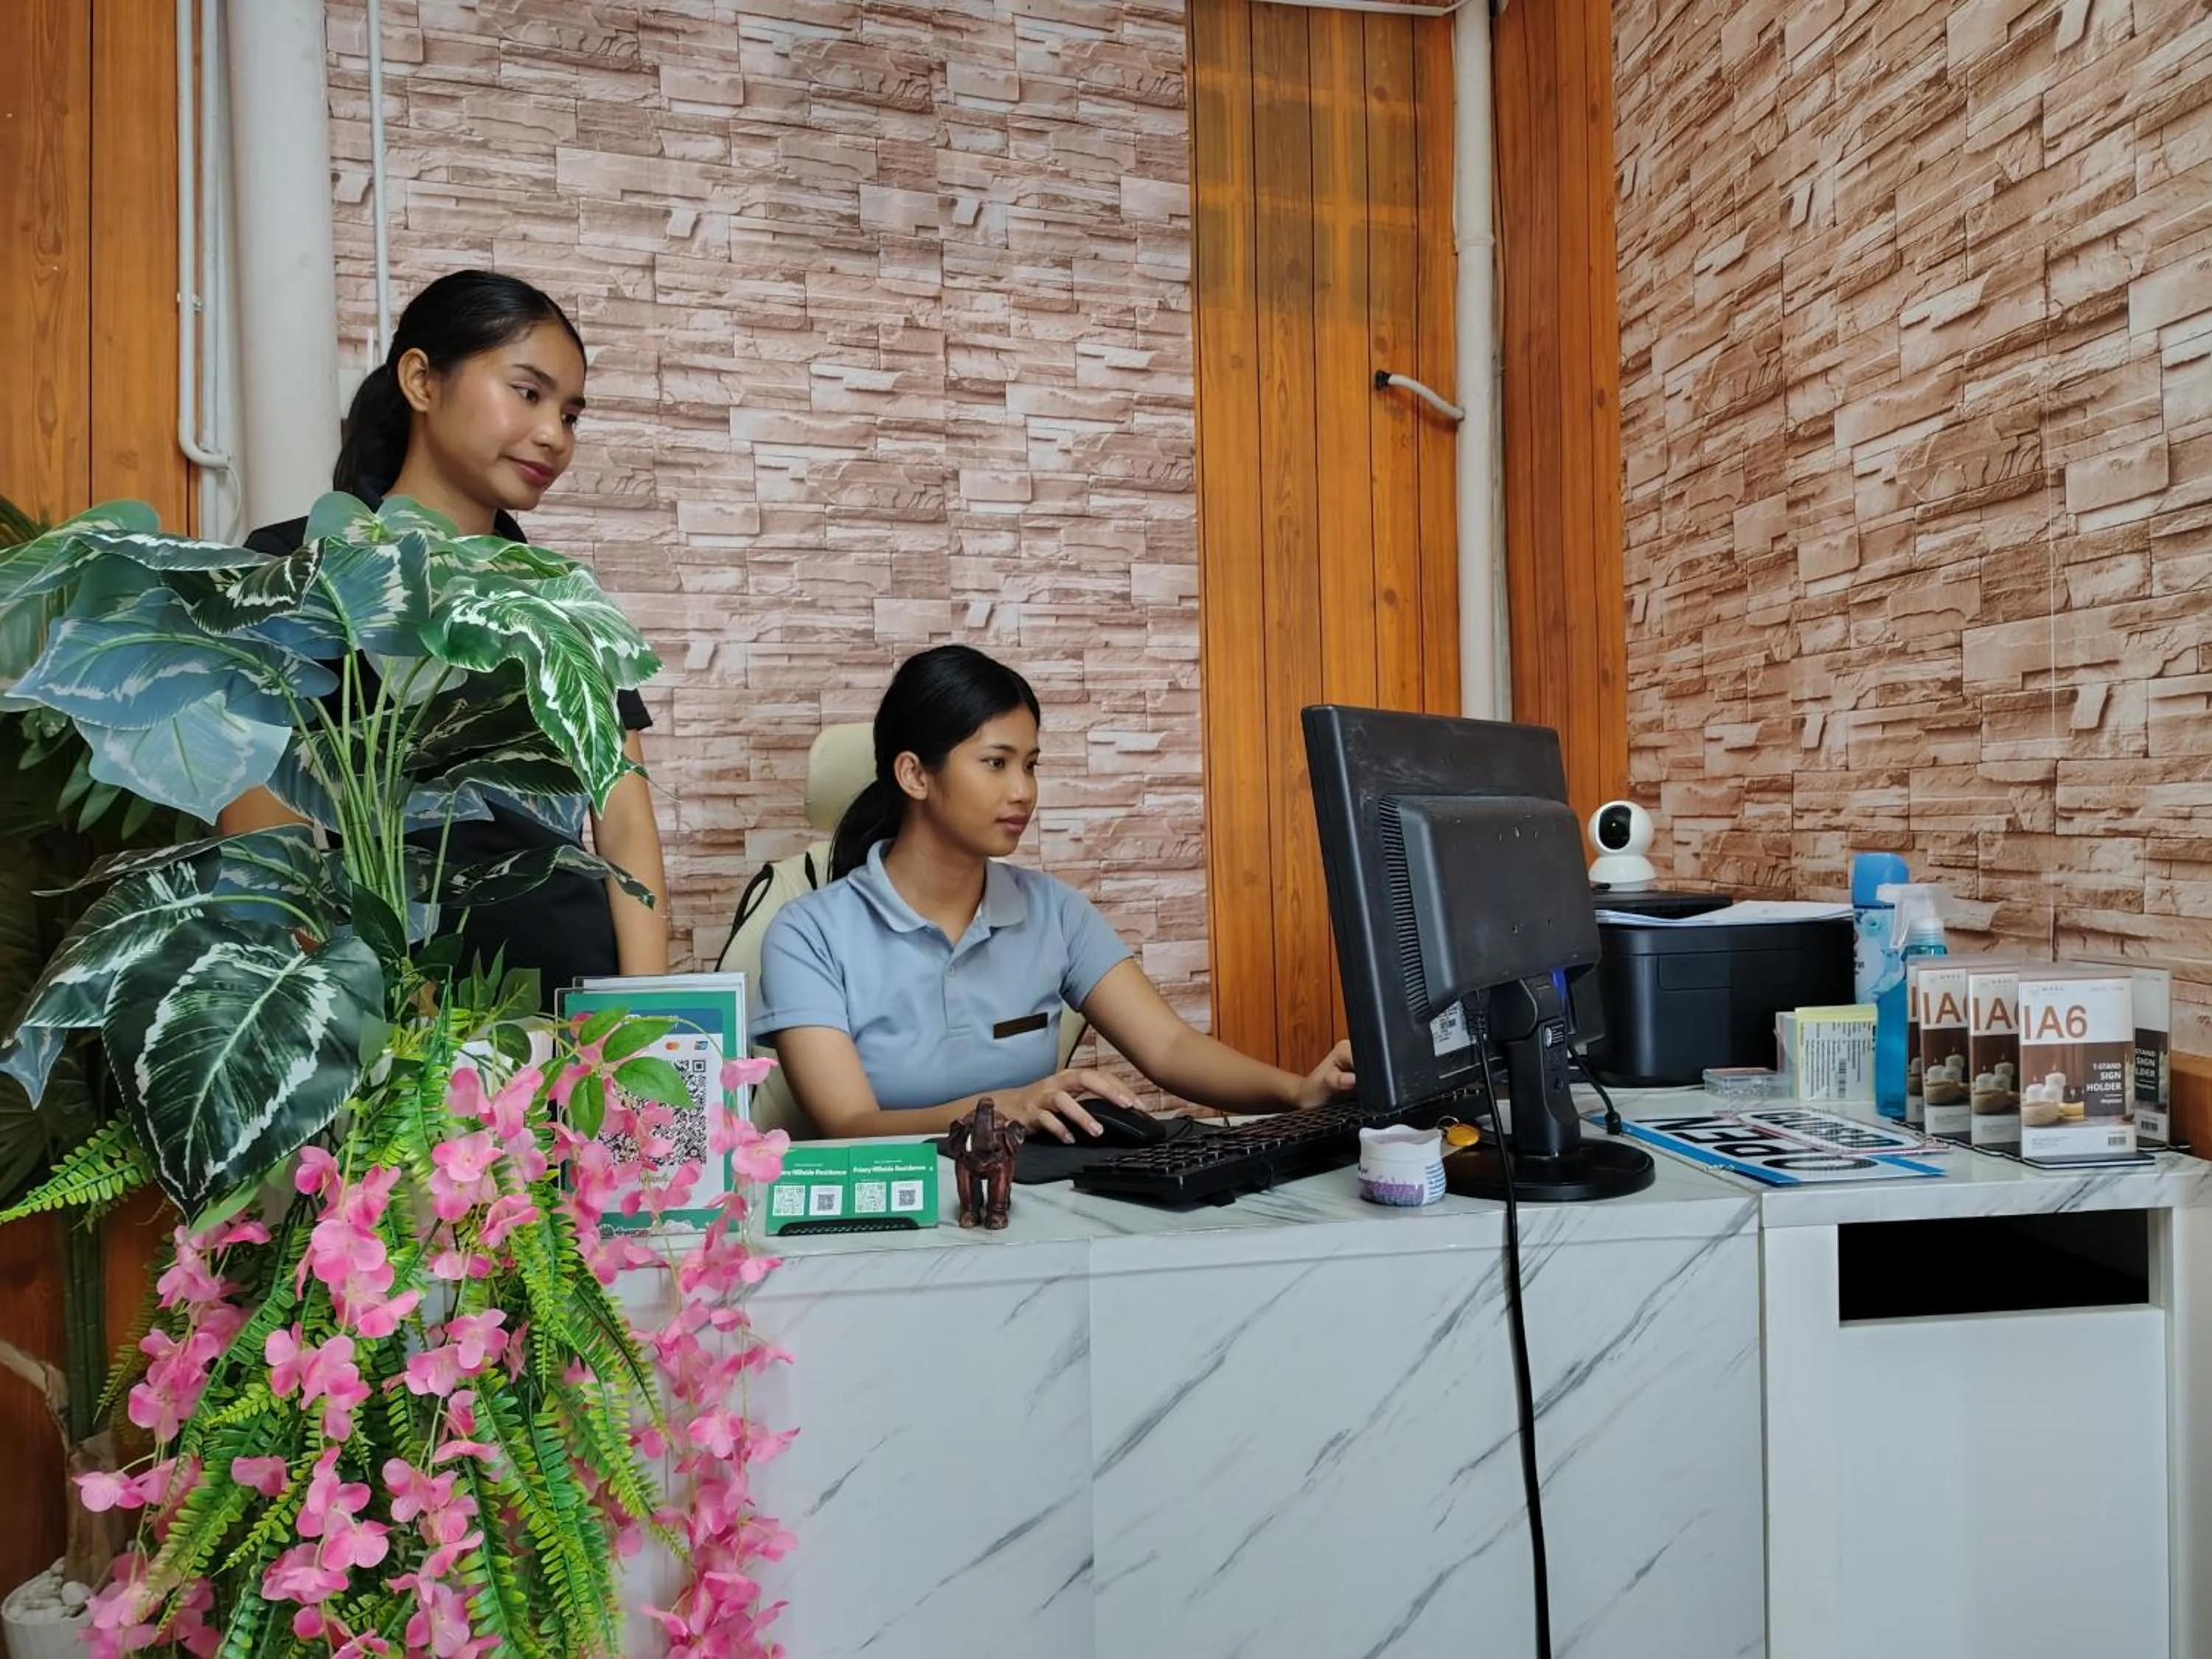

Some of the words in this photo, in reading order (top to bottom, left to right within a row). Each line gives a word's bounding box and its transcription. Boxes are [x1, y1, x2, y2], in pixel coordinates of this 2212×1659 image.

[1922, 992, 1968, 1025] IA
[2086, 1082, 2122, 1092] HOLDER
[2101, 1071, 2121, 1080] SIGN
[1632, 1116, 1879, 1171] OPEN
[1750, 1111, 1905, 1148] CLOSED
